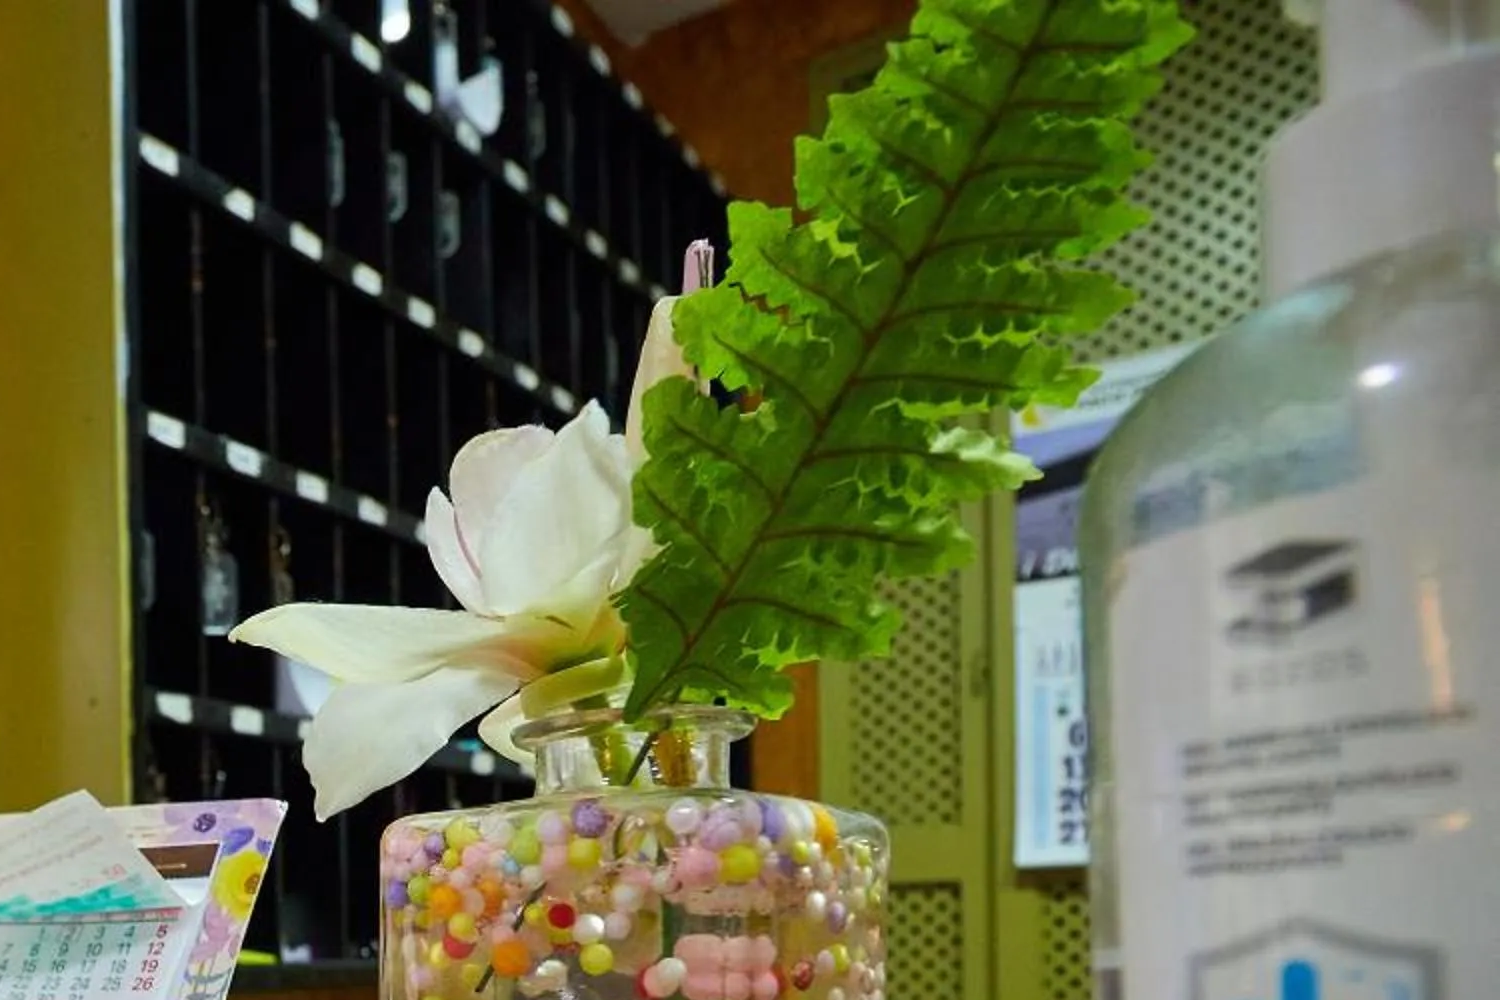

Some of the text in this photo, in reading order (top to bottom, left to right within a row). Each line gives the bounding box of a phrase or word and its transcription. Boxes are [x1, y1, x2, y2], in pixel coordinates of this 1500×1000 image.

[94, 926, 106, 940] 3
[123, 926, 135, 938] 4
[156, 924, 169, 938] 5
[57, 942, 69, 957] 9
[85, 943, 103, 957] 10
[117, 943, 131, 956] 11
[147, 942, 165, 956] 12
[22, 960, 37, 973] 15
[52, 960, 66, 973] 16
[111, 960, 127, 974] 18
[141, 960, 159, 974] 19
[69, 977, 91, 991] 24
[100, 977, 122, 991] 25
[132, 977, 154, 991] 26
